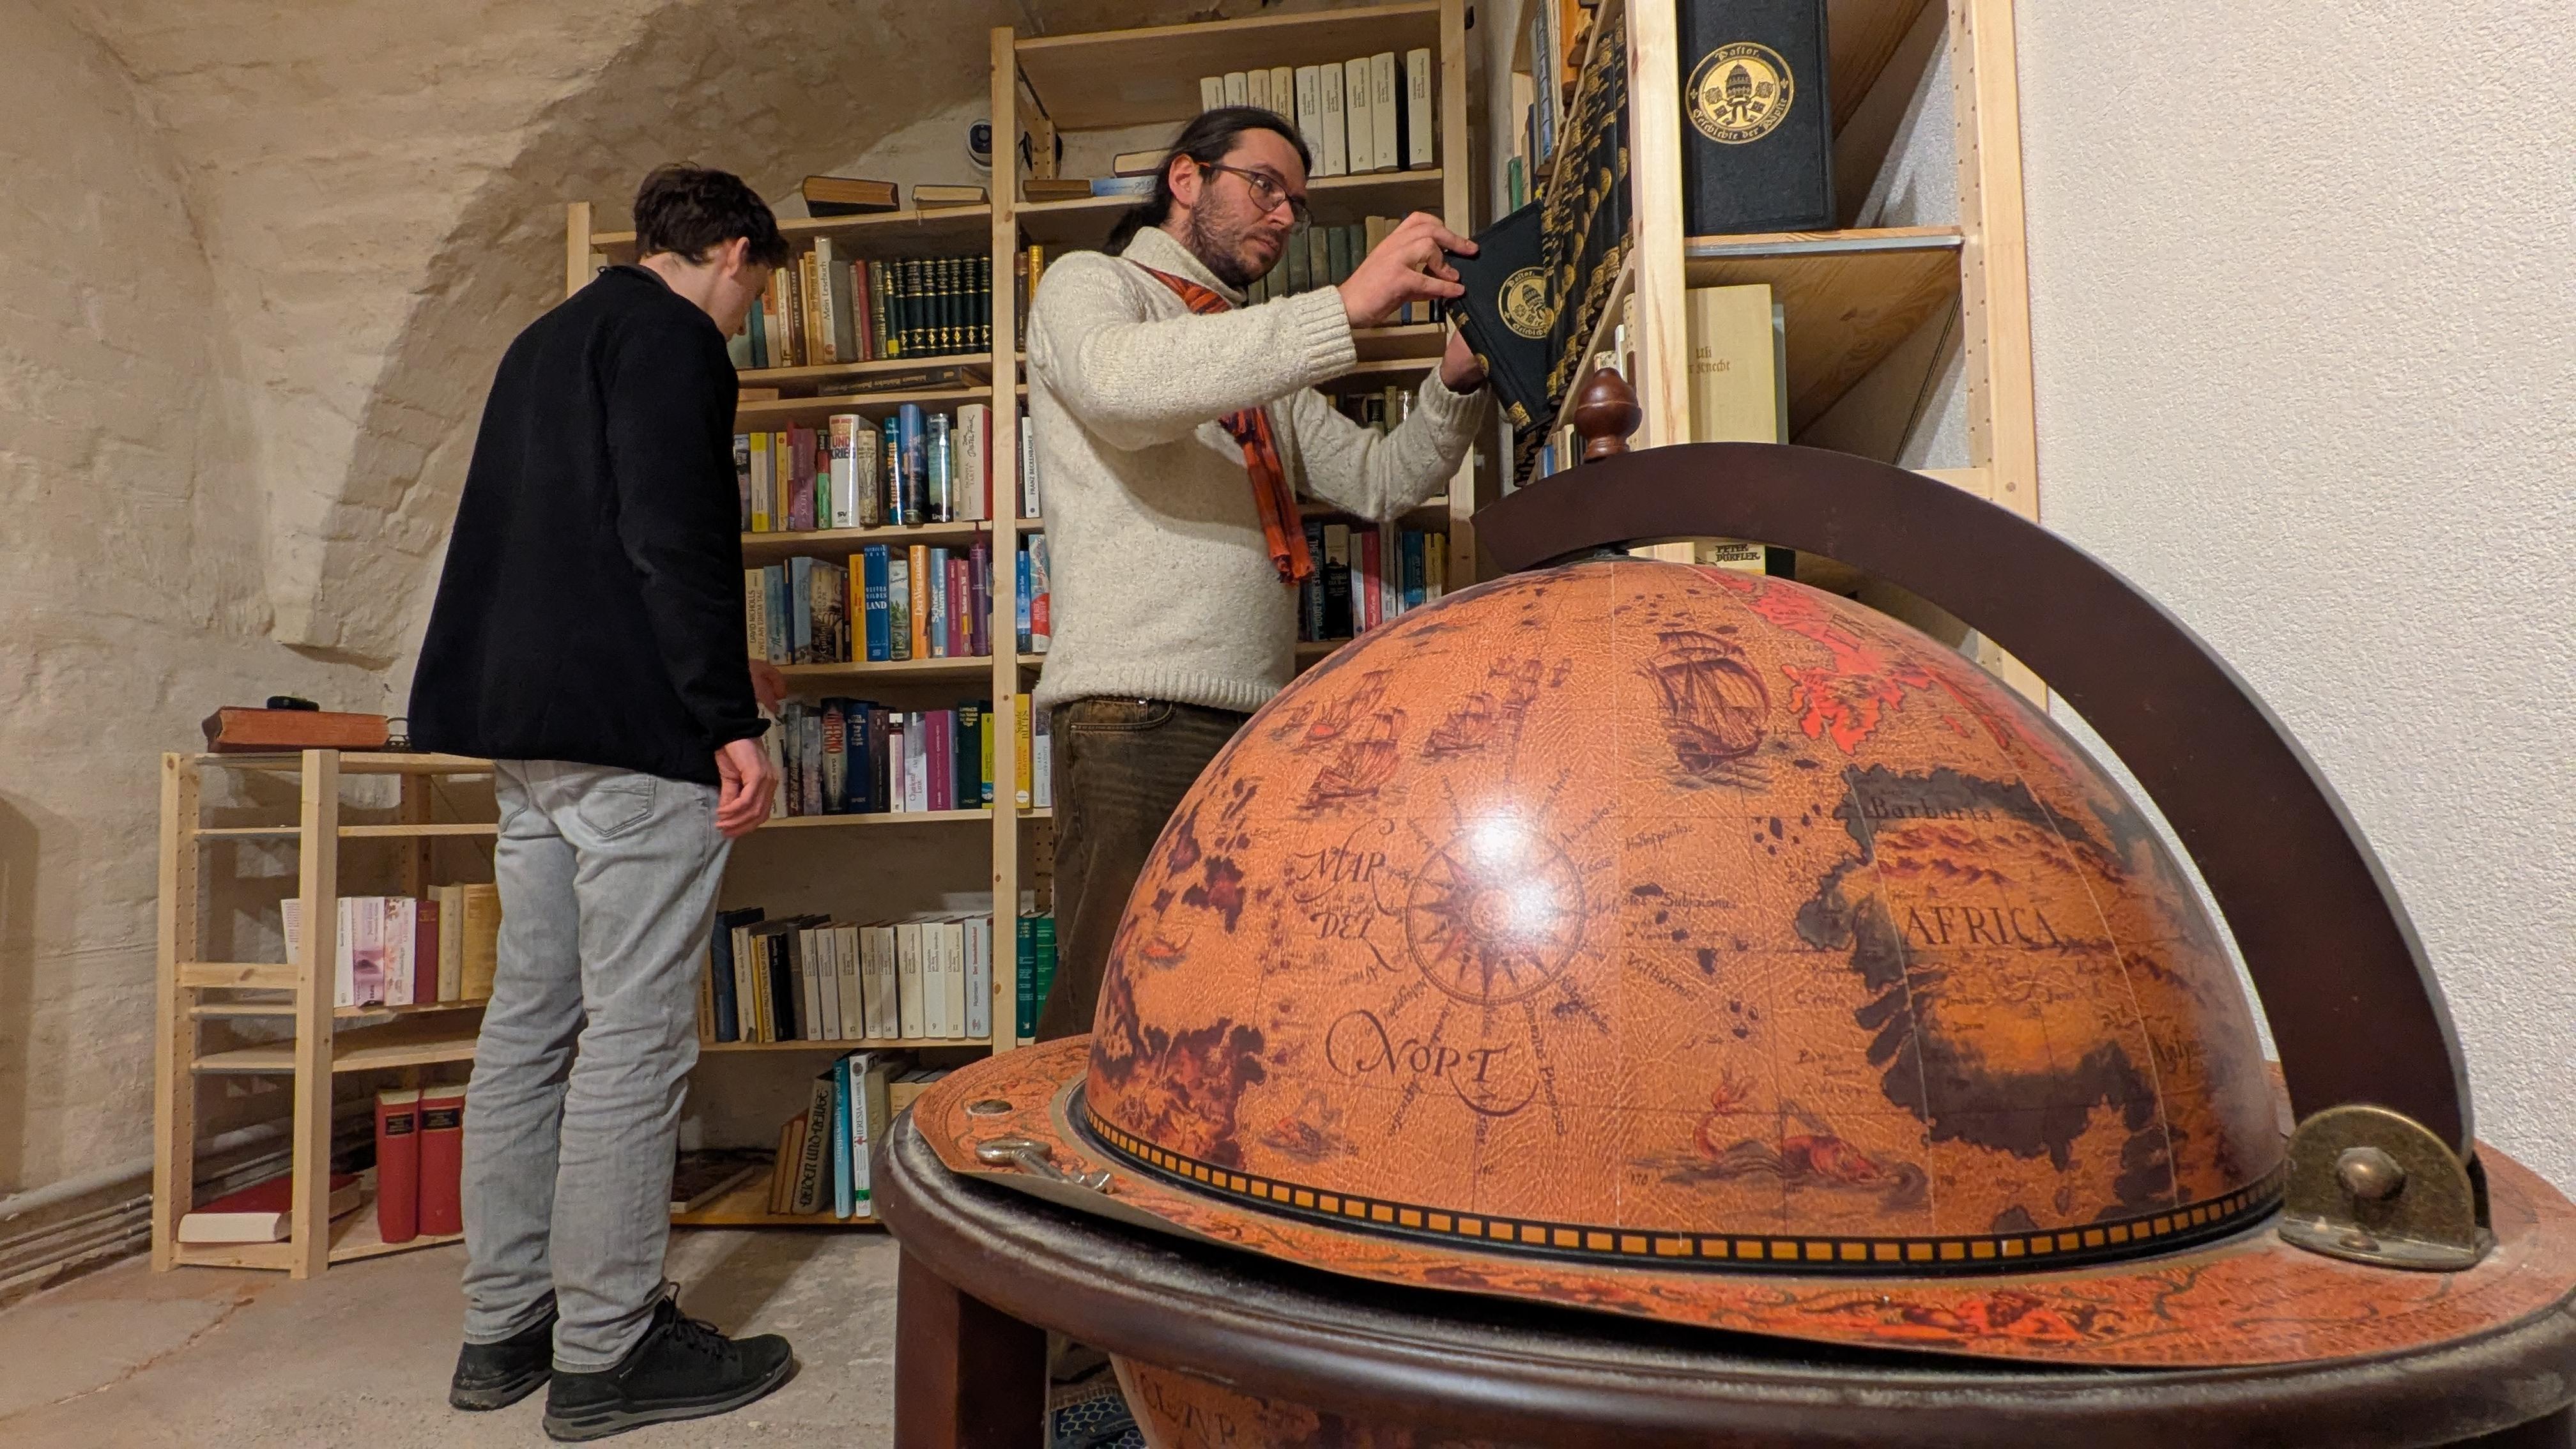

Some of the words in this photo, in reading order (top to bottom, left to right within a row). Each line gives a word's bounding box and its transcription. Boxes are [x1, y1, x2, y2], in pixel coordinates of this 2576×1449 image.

[820, 260, 830, 296] Lesebuch
[1309, 539, 1319, 553] THE
[1716, 544, 1749, 553] PETER
[1715, 552, 1761, 562] DÖRFLER
[914, 581, 923, 599] Weg
[866, 601, 887, 610] LAND
[915, 601, 923, 616] Der
[1902, 905, 2062, 948] AFRICA
